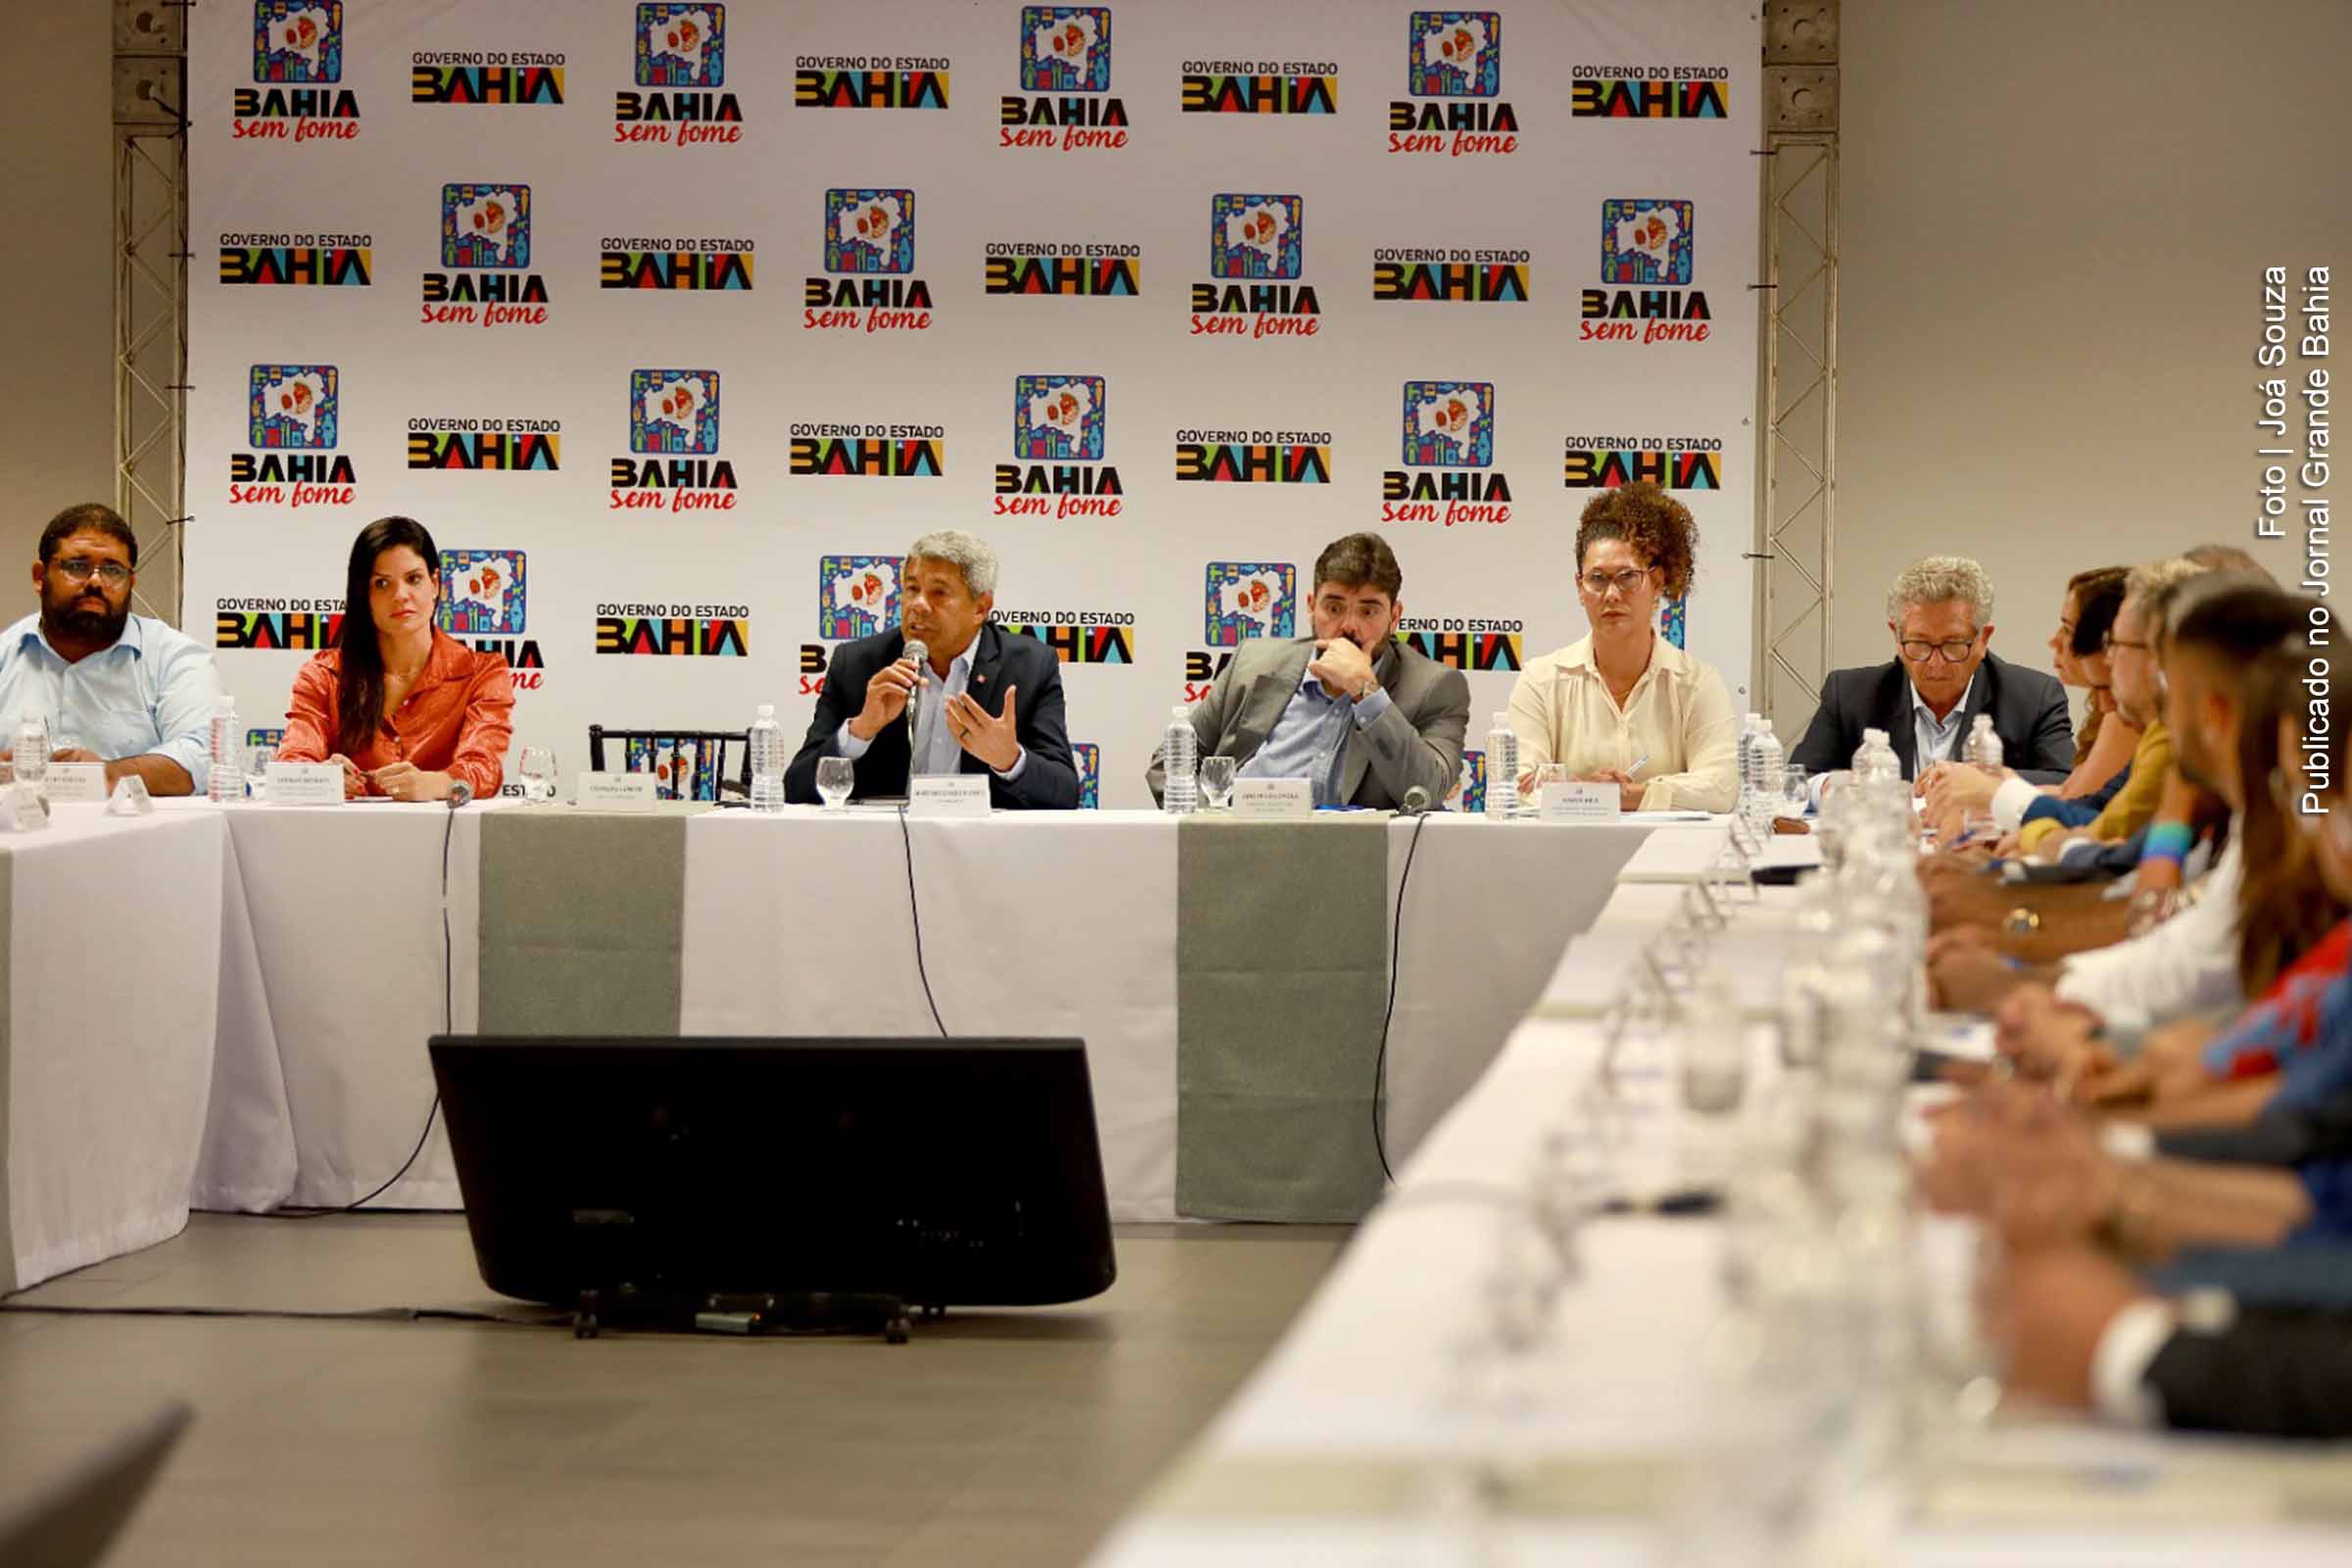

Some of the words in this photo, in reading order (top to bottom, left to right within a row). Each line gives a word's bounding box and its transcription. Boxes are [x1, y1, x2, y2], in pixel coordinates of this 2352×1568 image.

[413, 52, 483, 65] GOVERNO
[487, 53, 508, 66] DO
[512, 53, 565, 66] ESTADO
[796, 56, 866, 69] GOVERNO
[871, 57, 892, 70] DO
[896, 57, 950, 70] ESTADO
[1182, 61, 1253, 74] GOVERNO
[1258, 62, 1279, 74] DO
[1283, 63, 1338, 75] ESTADO
[1572, 66, 1644, 78] GOVERNO
[1648, 67, 1669, 79] DO
[1674, 67, 1729, 79] ESTADO
[234, 89, 360, 119] BAHIA
[616, 92, 742, 122] BAHIA
[1002, 97, 1128, 126] BAHIA
[1391, 102, 1518, 131] BAHIA
[295, 115, 361, 141] fome
[677, 118, 743, 145] fome
[1062, 122, 1128, 151] fome
[1451, 127, 1517, 157] fome
[220, 233, 290, 246] GOVERNO
[293, 234, 315, 247] DO
[318, 234, 371, 247] ESTADO
[601, 237, 671, 250] GOVERNO
[676, 239, 696, 251] DO
[701, 239, 755, 252] ESTADO
[986, 243, 1057, 256] GOVERNO
[1061, 244, 1082, 256] DO
[1086, 244, 1140, 257] ESTADO
[1374, 249, 1446, 262] GOVERNO
[1450, 249, 1471, 262] DO
[1475, 250, 1530, 263] ESTADO
[423, 273, 548, 303] BAHIA
[807, 278, 932, 308] BAHIA
[1193, 284, 1319, 314] BAHIA
[484, 299, 550, 327] fome
[867, 304, 933, 332] fome
[1583, 290, 1710, 319] BAHIA
[1253, 310, 1319, 339] fome
[1643, 316, 1709, 344] fome
[408, 417, 478, 430] GOVERNO
[482, 419, 503, 431] DO
[507, 419, 561, 432] ESTADO
[790, 423, 860, 436] GOVERNO
[865, 425, 886, 437] DO
[890, 425, 944, 438] ESTADO
[1176, 429, 1248, 442] GOVERNO
[1252, 431, 1273, 444] DO
[1277, 431, 1332, 444] ESTADO
[1566, 436, 1638, 449] GOVERNO
[1642, 438, 1662, 450] DO
[1667, 438, 1722, 451] ESTADO
[231, 455, 355, 484] BAHIA
[612, 460, 737, 489] BAHIA
[997, 466, 1122, 495] BAHIA
[292, 480, 358, 509] fome
[673, 485, 739, 513] fome
[1385, 472, 1510, 502] BAHIA
[1057, 491, 1123, 518] fome
[1446, 498, 1511, 525] fome
[217, 598, 286, 611] GOVERNO
[290, 600, 311, 612] DO
[315, 599, 346, 612] ESTA
[597, 604, 666, 616] GOVERNO
[671, 605, 691, 616] DO
[696, 606, 749, 617] ESTADO
[991, 611, 1051, 623] OVERNO
[1055, 612, 1075, 623] DO
[1080, 612, 1134, 624] ESTADO
[217, 612, 345, 649] BAHI
[1399, 618, 1439, 631] ERNO
[1444, 619, 1463, 631] DO
[1468, 619, 1523, 632] ESTADO
